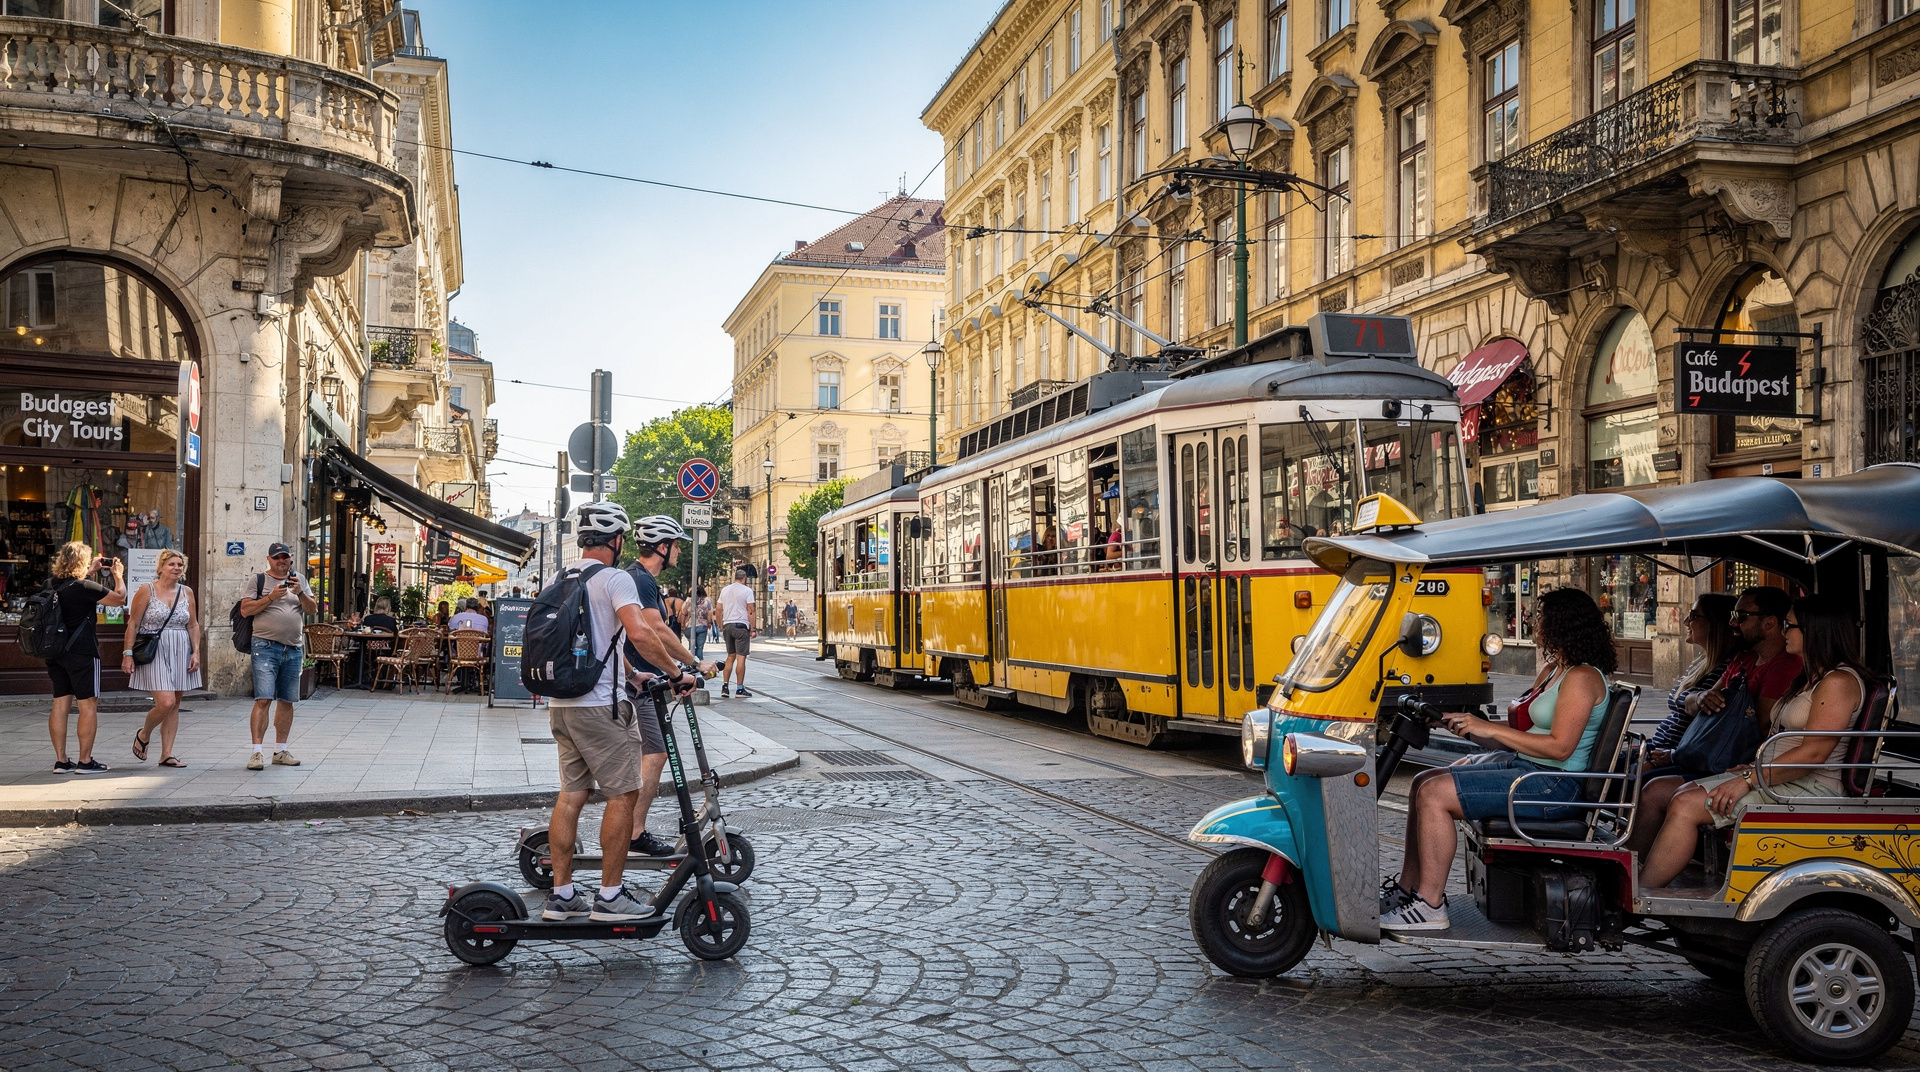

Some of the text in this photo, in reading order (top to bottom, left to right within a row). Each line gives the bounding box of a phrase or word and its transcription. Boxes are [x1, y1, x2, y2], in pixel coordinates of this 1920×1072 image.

[1685, 350, 1718, 366] Café
[1689, 370, 1790, 402] Budapest
[20, 392, 116, 419] Budagest
[22, 417, 123, 442] City Tours
